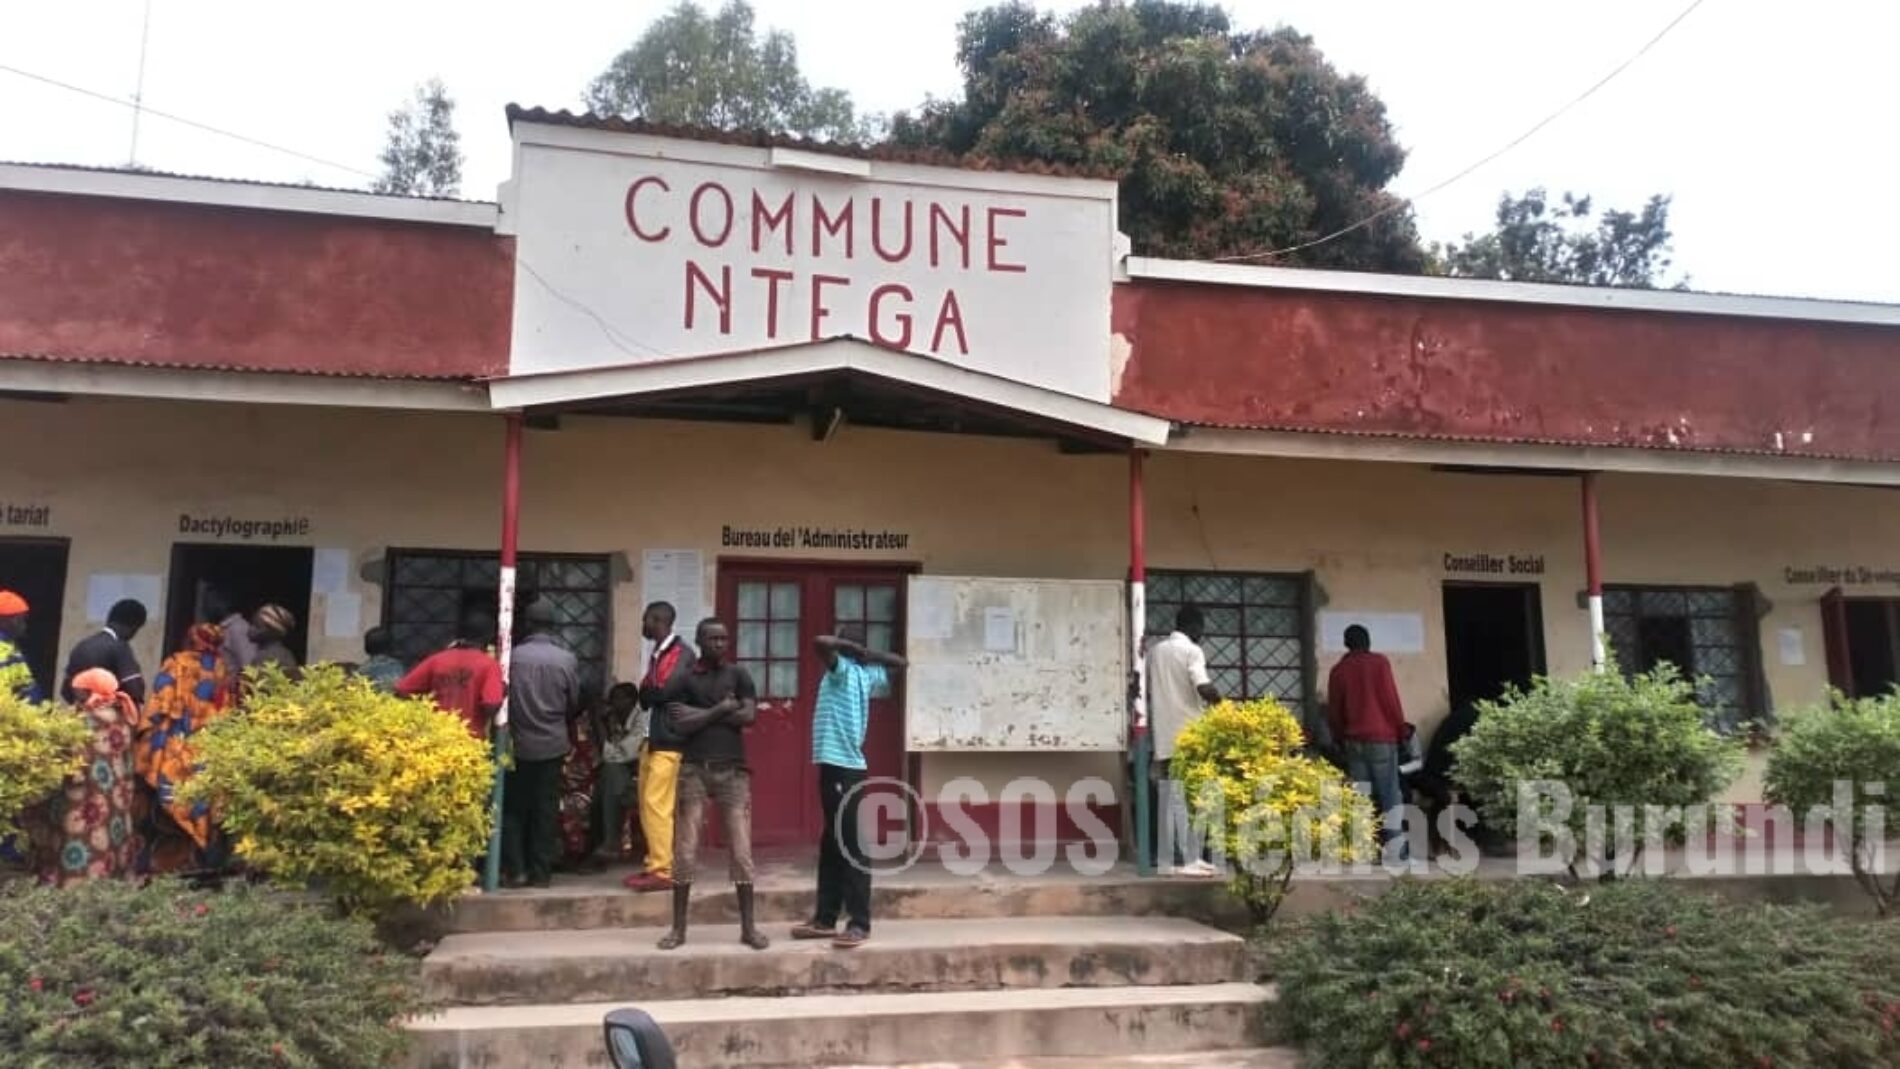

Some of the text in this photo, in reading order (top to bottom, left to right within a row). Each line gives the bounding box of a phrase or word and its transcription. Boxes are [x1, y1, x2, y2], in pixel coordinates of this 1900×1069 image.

[624, 175, 1027, 273] COMMUNE
[683, 259, 969, 355] NTEGA
[179, 514, 310, 540] Dactylographie
[721, 525, 770, 547] Bureau
[1508, 554, 1545, 575] Social
